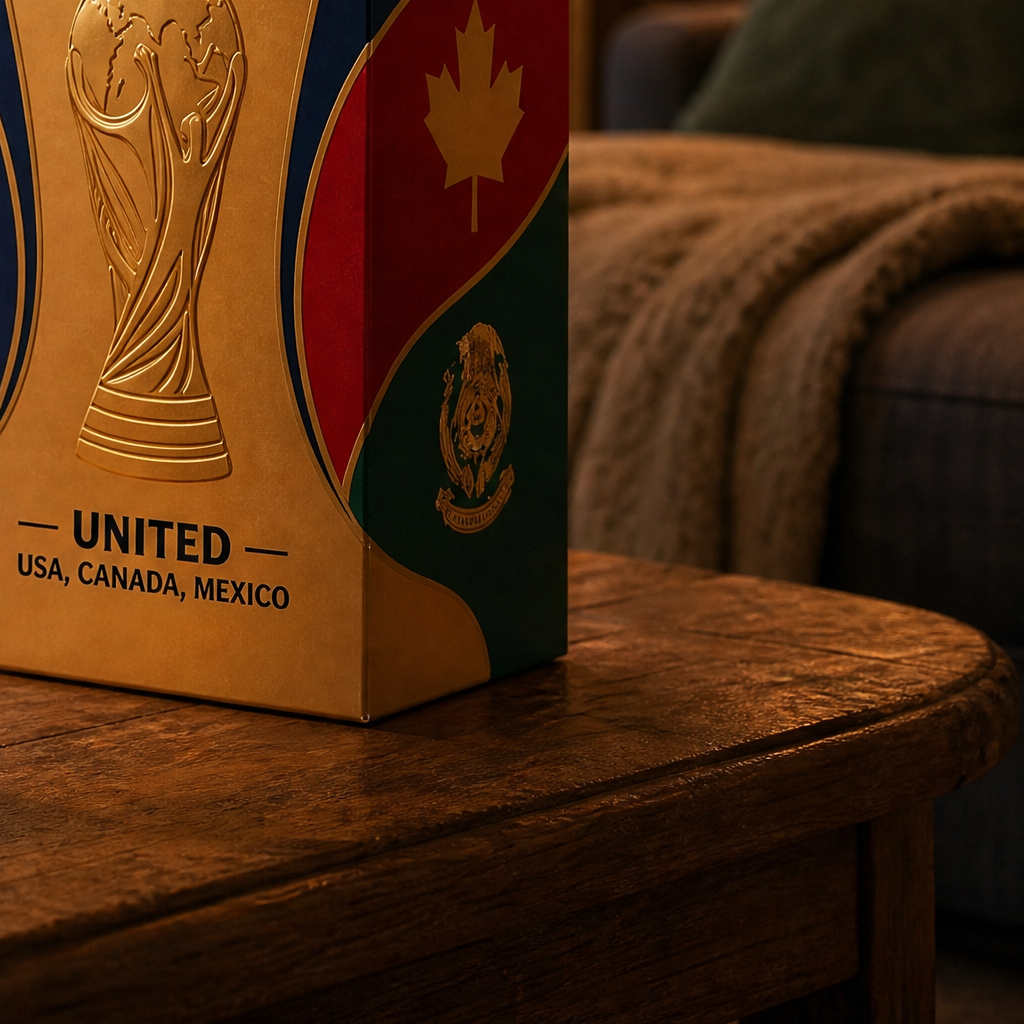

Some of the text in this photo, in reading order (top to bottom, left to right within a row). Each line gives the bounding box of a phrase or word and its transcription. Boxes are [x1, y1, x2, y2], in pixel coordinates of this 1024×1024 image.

[73, 509, 231, 565] UNITED
[17, 552, 290, 610] USA, CANADA, MEXICO
